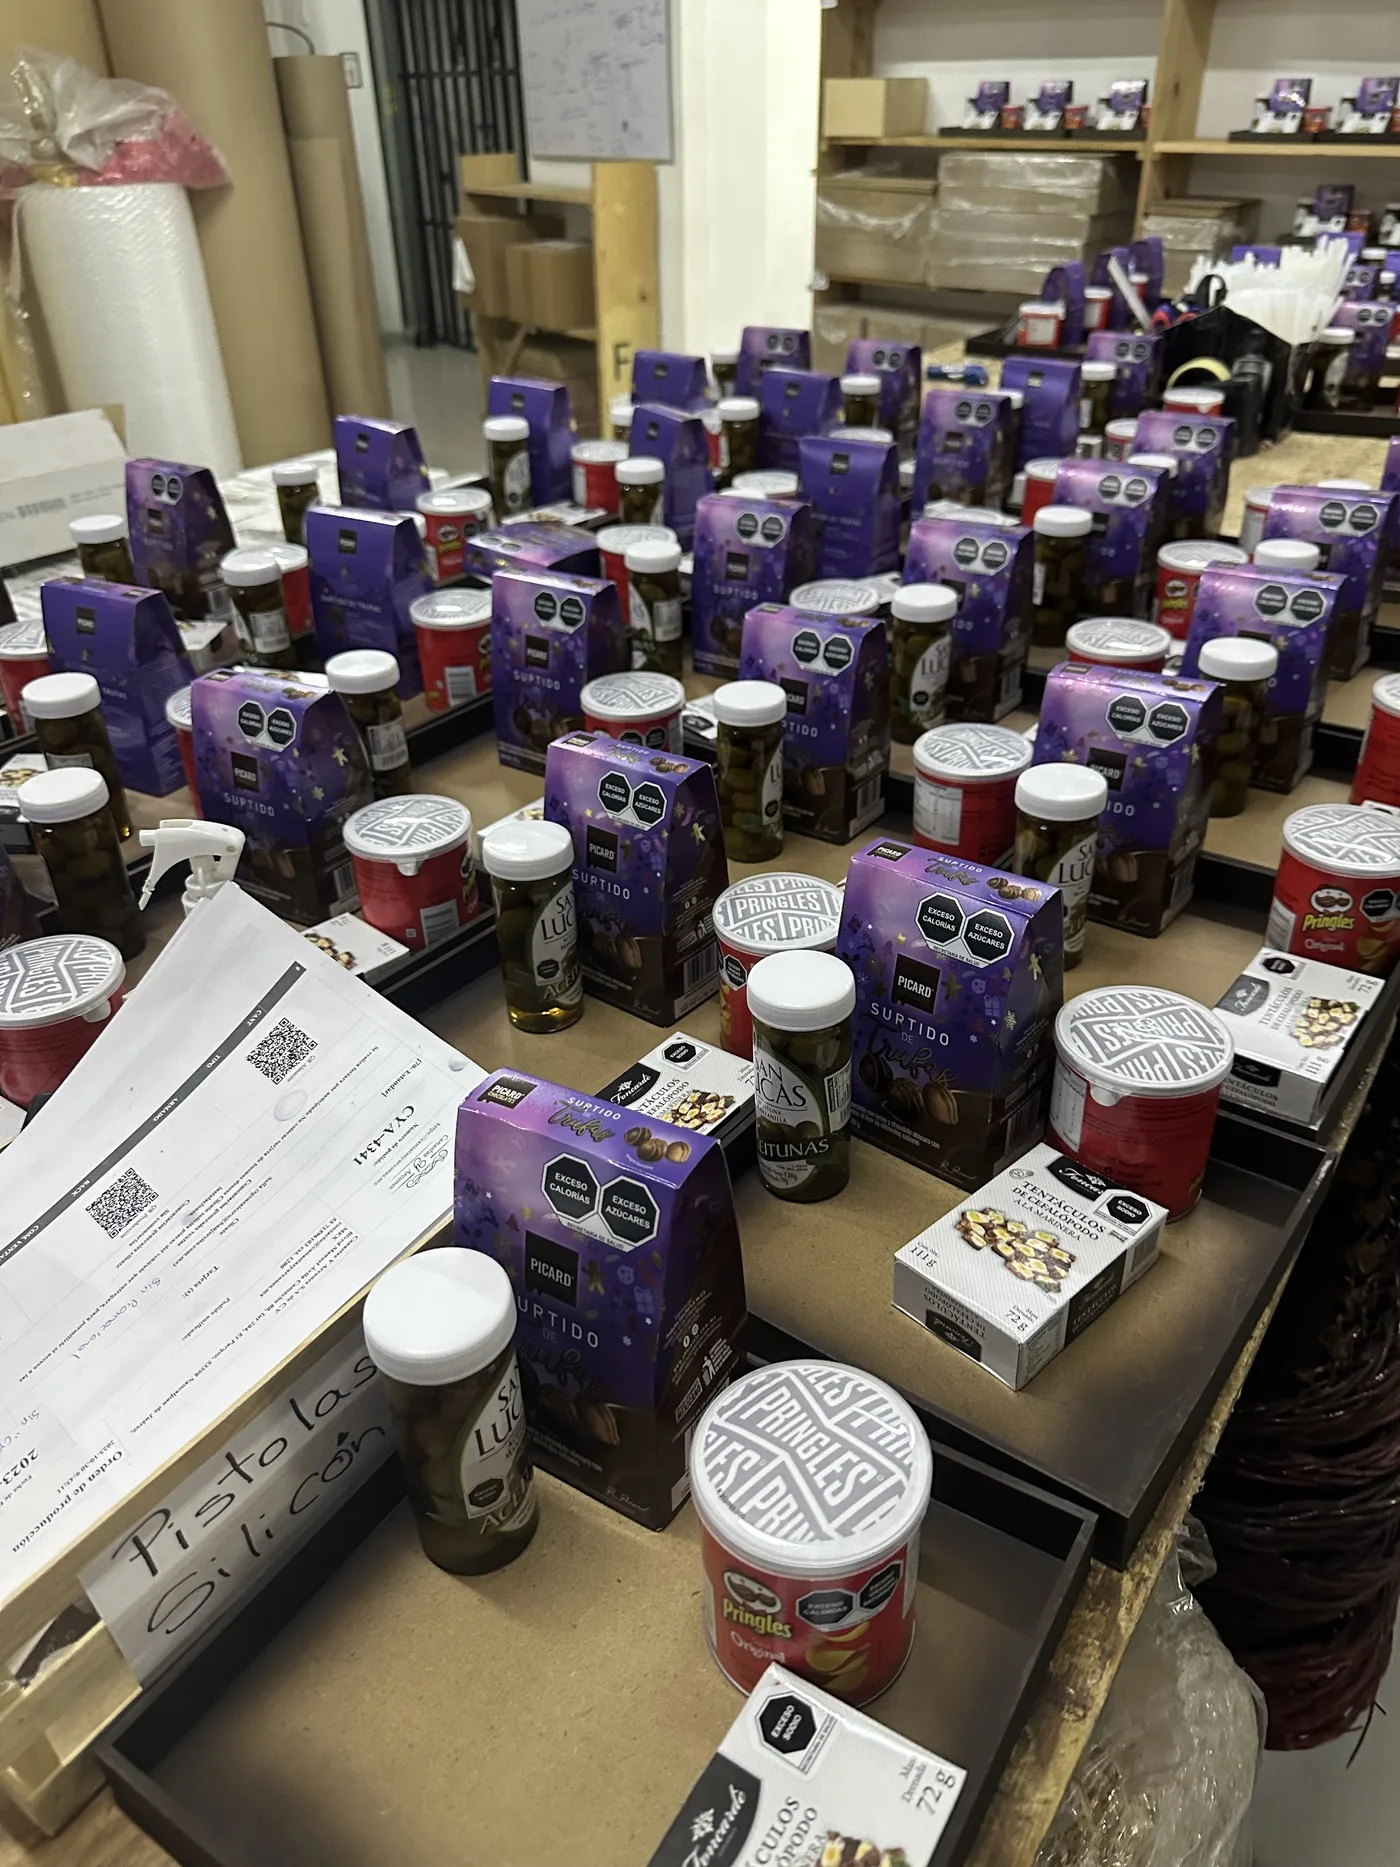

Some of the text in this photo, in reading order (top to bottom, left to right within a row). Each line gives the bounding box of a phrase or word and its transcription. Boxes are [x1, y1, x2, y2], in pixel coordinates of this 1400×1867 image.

[604, 783, 625, 794] EXCESO
[638, 794, 660, 805] EXCESO
[589, 843, 615, 860] PICARD
[877, 846, 902, 857] PICARD
[938, 856, 982, 873] SURTIDO
[572, 868, 630, 900] SURTIDO
[734, 892, 821, 918] PRINGLES
[928, 906, 955, 921] EXCESO
[922, 915, 956, 932] CALORÍAS
[974, 923, 1003, 938] EXCESO
[1302, 914, 1355, 932] Pringles
[968, 932, 1006, 950] AZÚCARES
[1304, 938, 1345, 952] Original
[898, 976, 932, 998] PICARD
[247, 1010, 261, 1026] CANT
[870, 1002, 949, 1046] SURTIDO
[902, 1032, 914, 1044] DE
[207, 1055, 221, 1068] TIPO
[488, 1090, 516, 1104] CHOCOLATES
[491, 1084, 522, 1100] PICARD
[149, 1097, 178, 1121] ARMADO
[567, 1097, 622, 1120] SURTIDO
[548, 1100, 616, 1142] Trufas
[354, 1106, 414, 1165] CYA-4341
[389, 1135, 448, 1189] Canastas Arcones
[72, 1180, 90, 1196] RACK
[555, 1172, 588, 1192] EXCESO
[550, 1182, 590, 1205] CALORÍAS
[612, 1195, 647, 1214] EXCESO
[606, 1204, 651, 1230] AZÚCARES
[1012, 1187, 1098, 1241] DE CEFALÓPODO
[1023, 1181, 1106, 1234] TENTÁCULOS
[1116, 1205, 1136, 1218] SODIO
[1117, 1200, 1142, 1216] EXCESO
[1034, 1208, 1081, 1242] MARINERA
[910, 1246, 937, 1268] 111 g
[194, 1266, 219, 1287] Tarjeta
[530, 1257, 572, 1287] PICARD
[72, 1278, 160, 1359] Sin Promocional
[517, 1296, 599, 1348] URTIDO
[1005, 1310, 1028, 1332] 72 g
[543, 1328, 558, 1344] DE
[740, 1382, 878, 1508] PRINGLES
[113, 1356, 378, 1576] Pistolas
[12, 1452, 122, 1552] Orden de producción
[147, 1431, 386, 1635] Silicón
[723, 1598, 792, 1639] Pringles
[730, 1631, 786, 1662] Original
[770, 1704, 796, 1738] EXCESO
[782, 1714, 802, 1740] SODIO
[916, 1770, 956, 1816] 72 g
